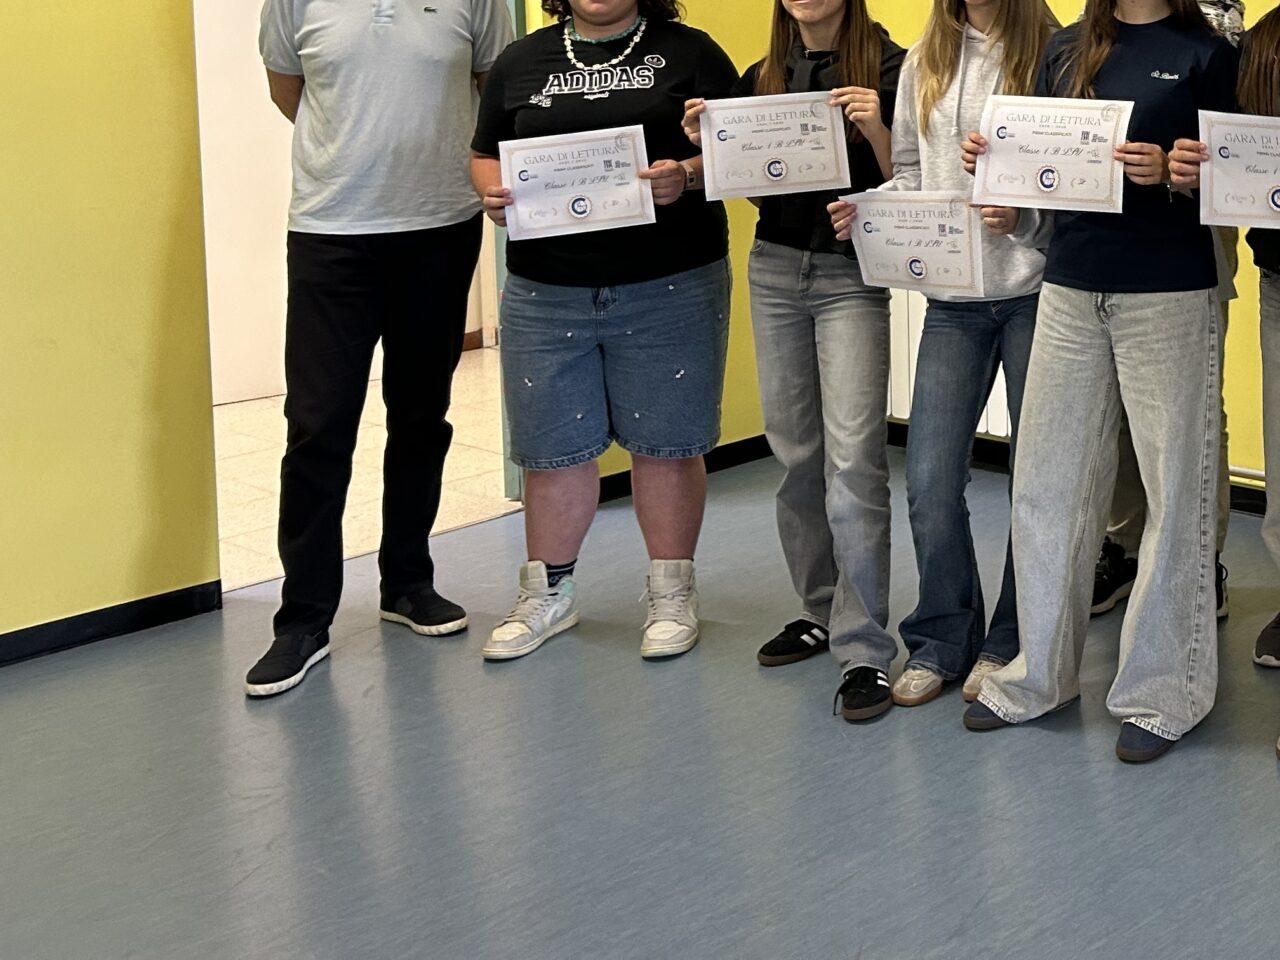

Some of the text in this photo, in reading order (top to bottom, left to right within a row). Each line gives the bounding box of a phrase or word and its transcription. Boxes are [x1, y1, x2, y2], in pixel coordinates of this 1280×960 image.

[543, 65, 654, 95] ADIDAS
[1006, 113, 1101, 126] GARA DI LETTURA
